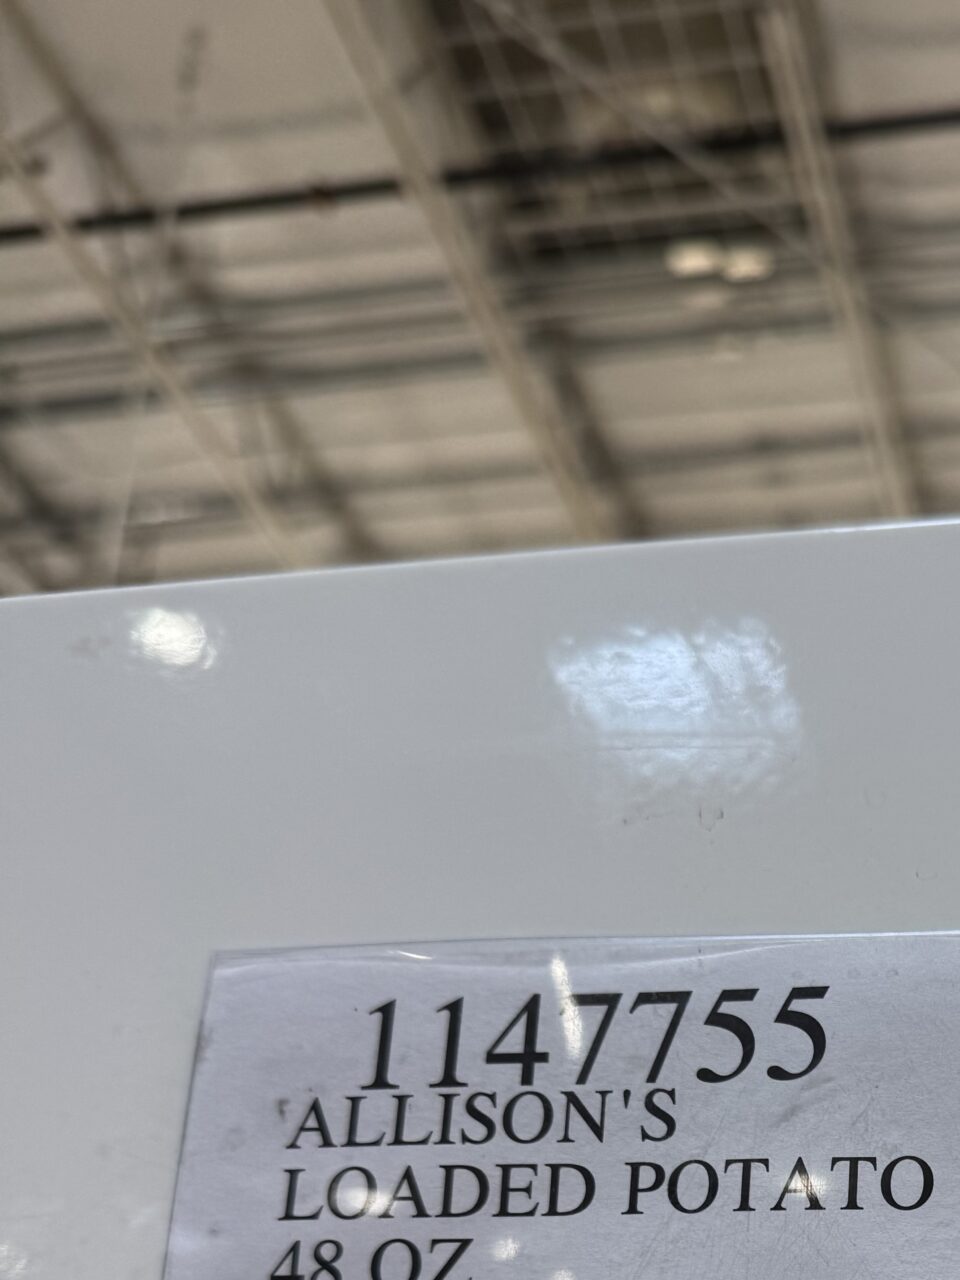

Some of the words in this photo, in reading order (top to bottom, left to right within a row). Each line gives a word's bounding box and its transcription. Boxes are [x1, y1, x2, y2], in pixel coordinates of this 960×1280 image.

[360, 986, 830, 1089] 1147755
[286, 1087, 678, 1149] ALLISON'S
[277, 1163, 597, 1221] LOADED
[621, 1155, 934, 1215] POTATO
